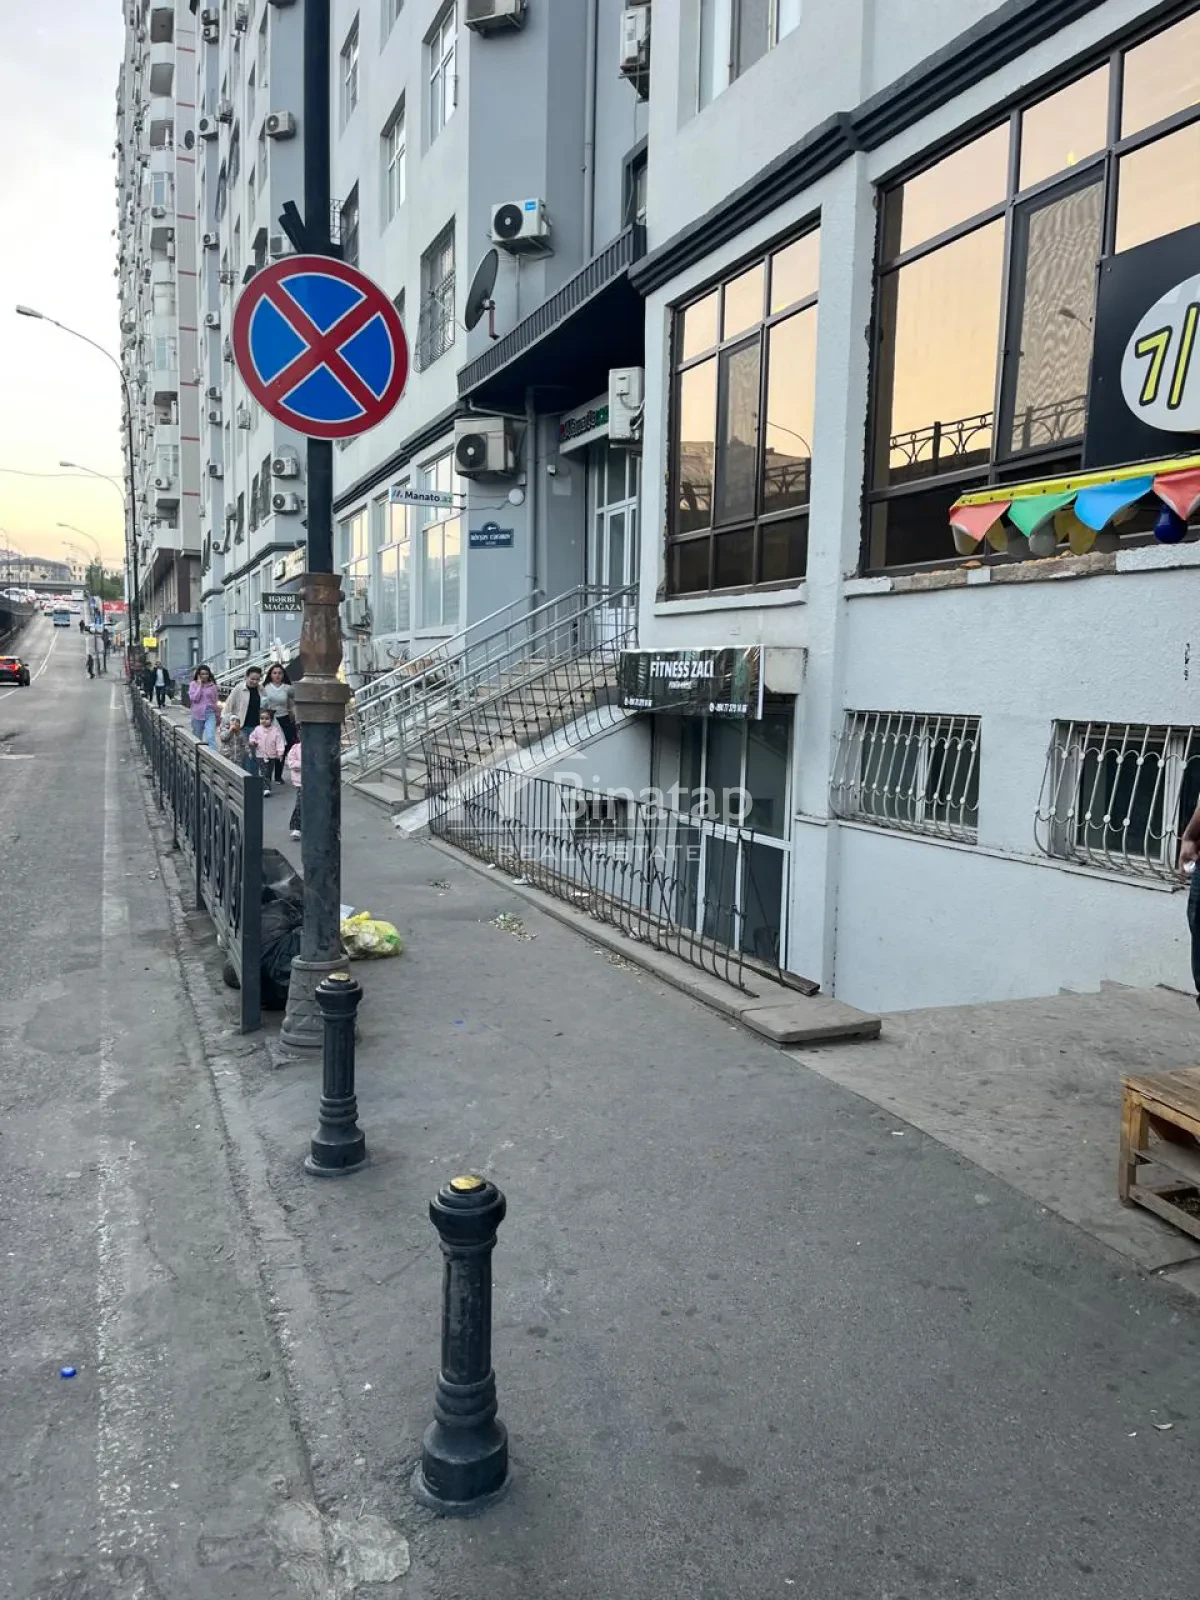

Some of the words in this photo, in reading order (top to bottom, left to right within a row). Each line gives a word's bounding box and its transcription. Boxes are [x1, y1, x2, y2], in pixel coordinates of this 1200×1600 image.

[264, 602, 301, 611] MAĞAZA
[650, 656, 690, 678] FİTNESS
[691, 660, 714, 678] ZALI
